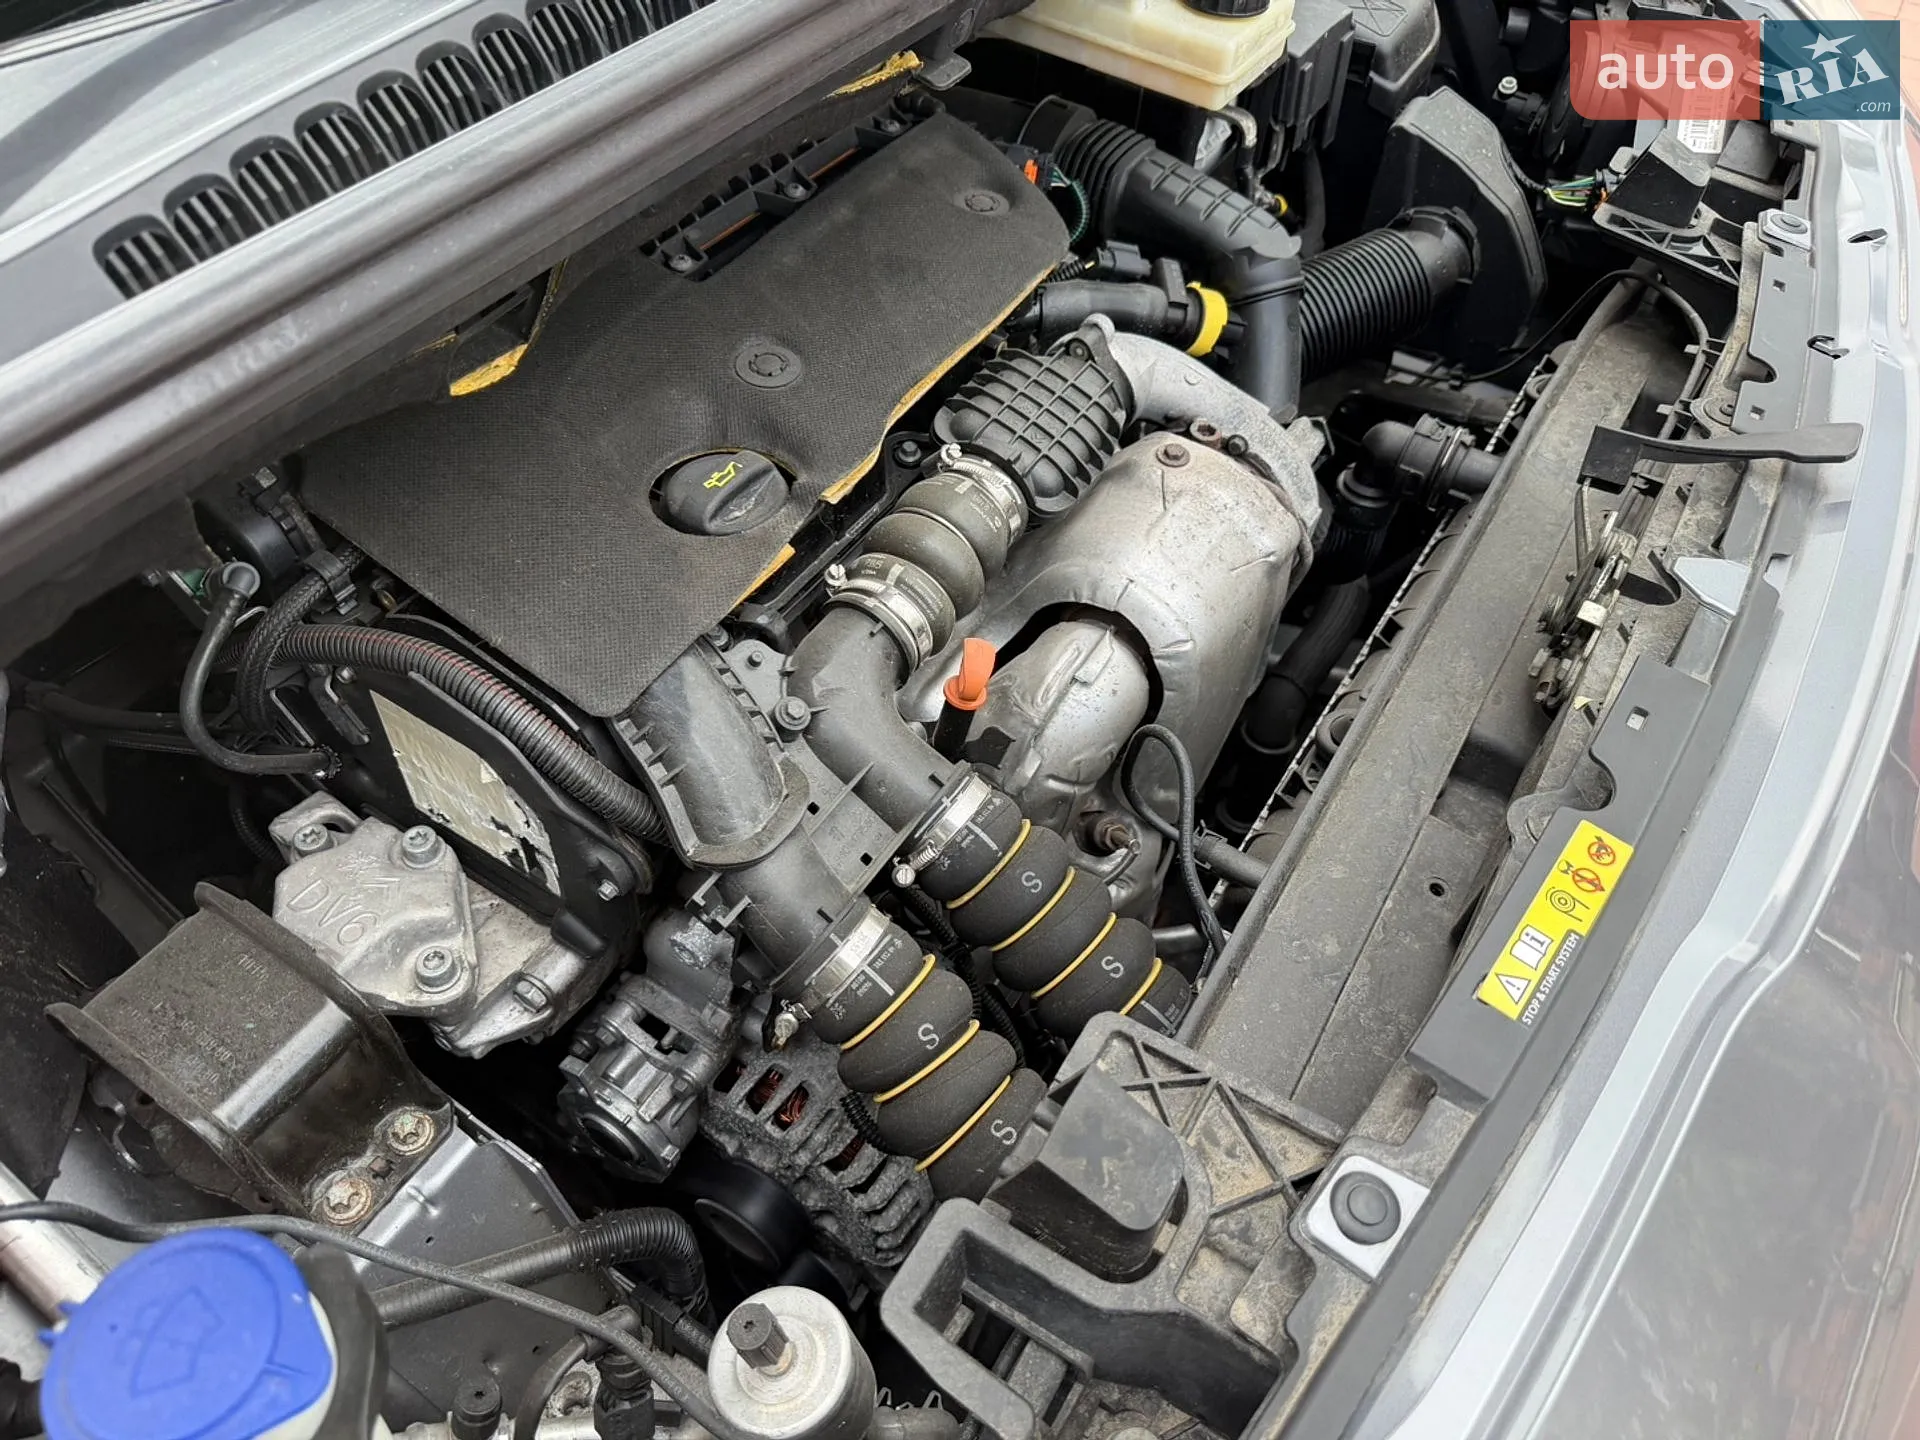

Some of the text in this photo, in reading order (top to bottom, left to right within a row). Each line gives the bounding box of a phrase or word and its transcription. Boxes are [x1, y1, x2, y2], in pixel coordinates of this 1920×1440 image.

[286, 878, 380, 946] DV6
[1522, 932, 1580, 1025] STOP & START SYSTEM
